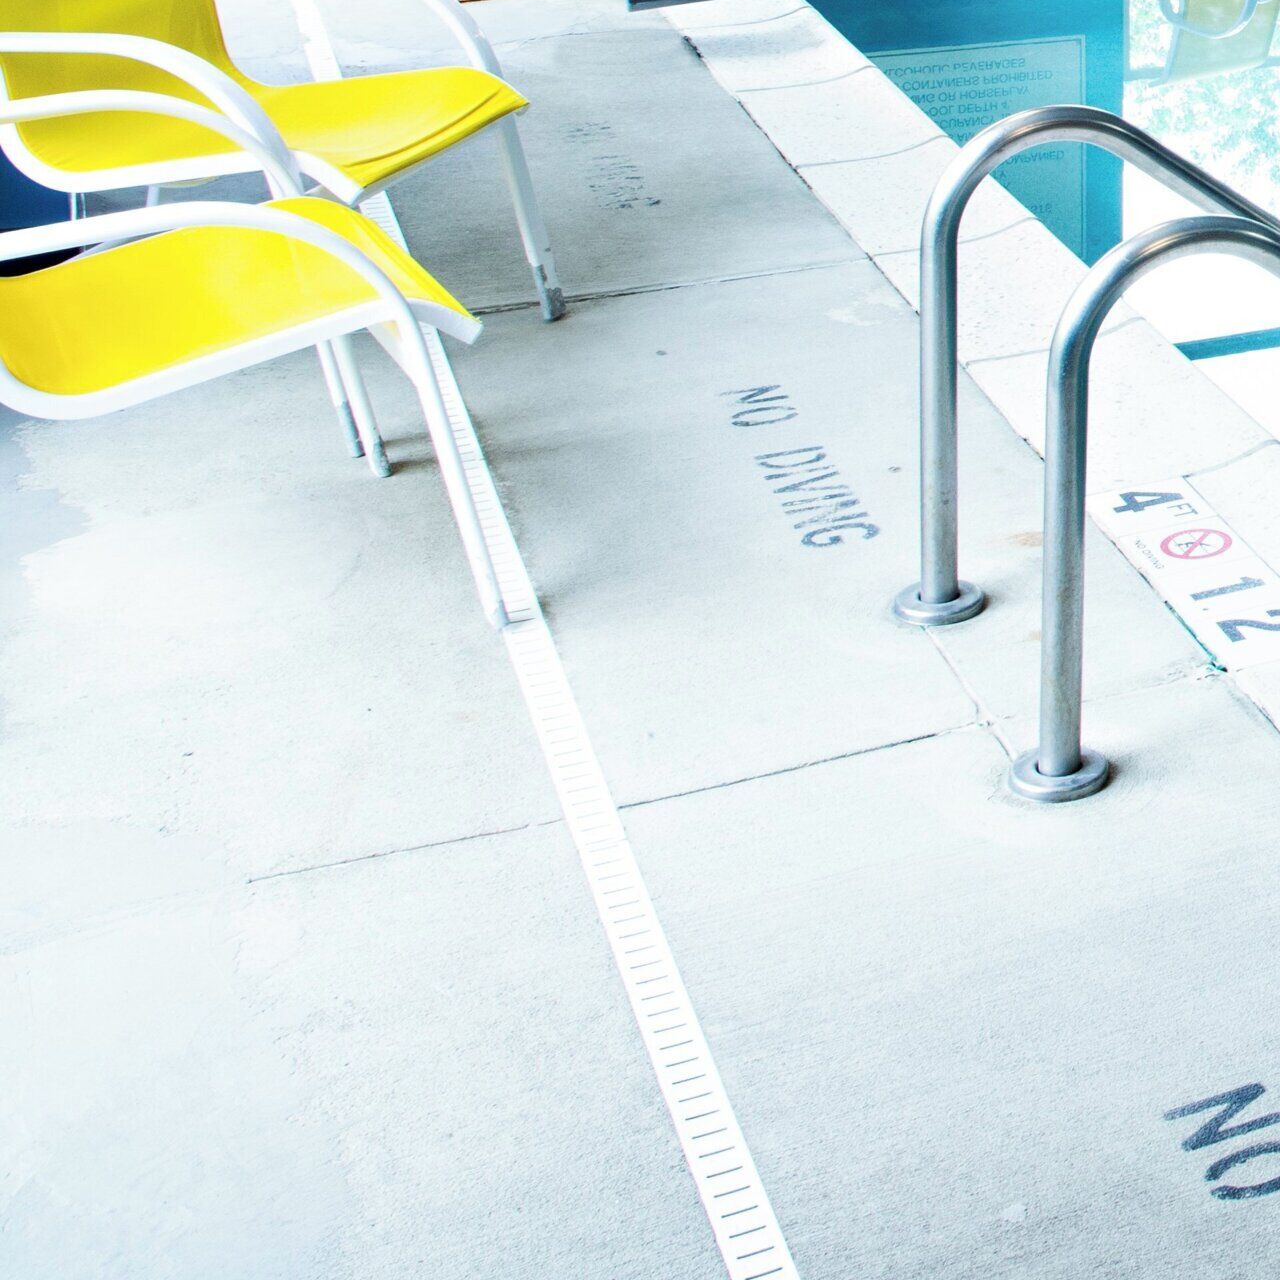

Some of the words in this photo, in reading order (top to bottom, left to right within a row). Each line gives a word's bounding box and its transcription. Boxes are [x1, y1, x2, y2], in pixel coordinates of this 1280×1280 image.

[716, 384, 799, 427] NO
[754, 445, 881, 548] DIVING
[1112, 491, 1184, 514] 4
[1166, 502, 1199, 517] FT
